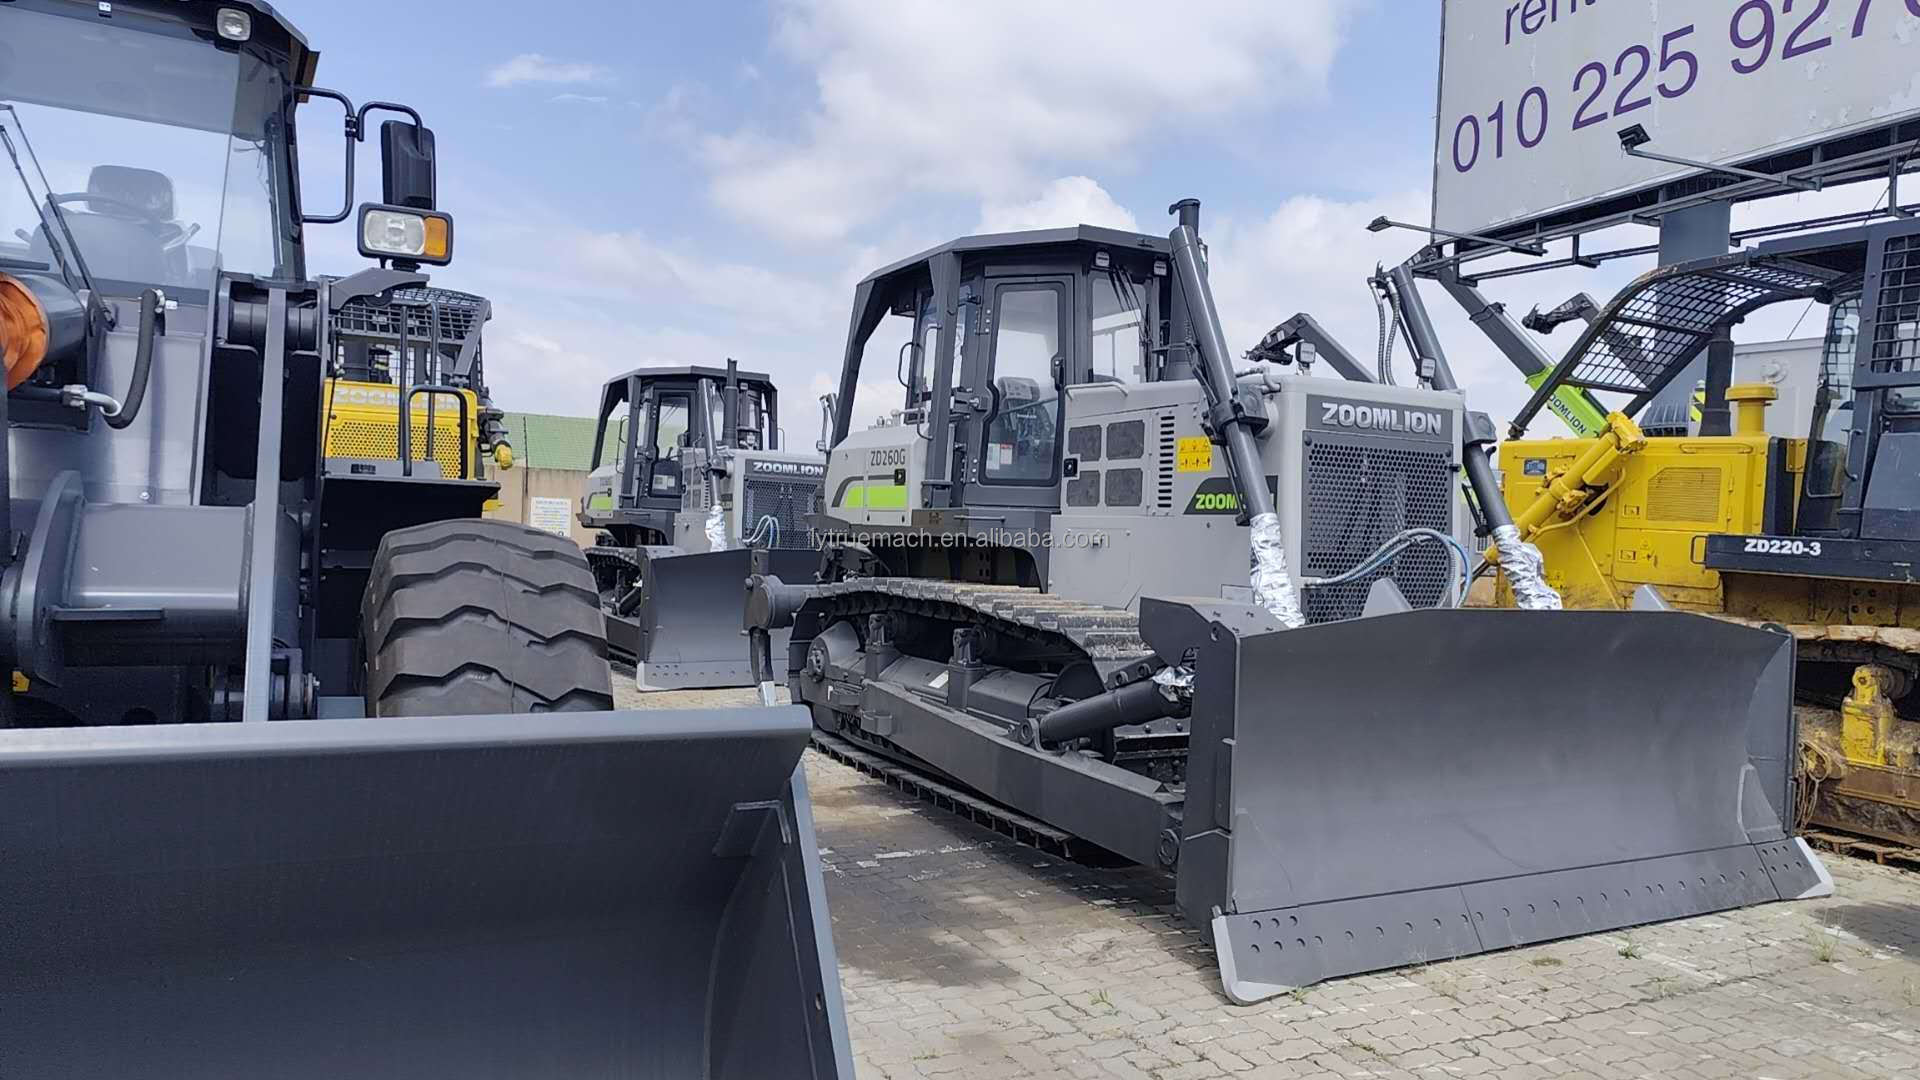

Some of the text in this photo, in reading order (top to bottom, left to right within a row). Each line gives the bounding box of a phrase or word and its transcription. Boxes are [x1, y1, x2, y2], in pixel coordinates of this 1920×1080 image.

[1505, 0, 1596, 45] re
[1453, 0, 1920, 172] 010 225 92
[1321, 402, 1442, 434] ZOOMLION
[1551, 394, 1587, 434] OMLION
[752, 461, 824, 476] ZOOMLION
[870, 448, 906, 467] ZD260G
[1744, 538, 1821, 556] ZD220-3
